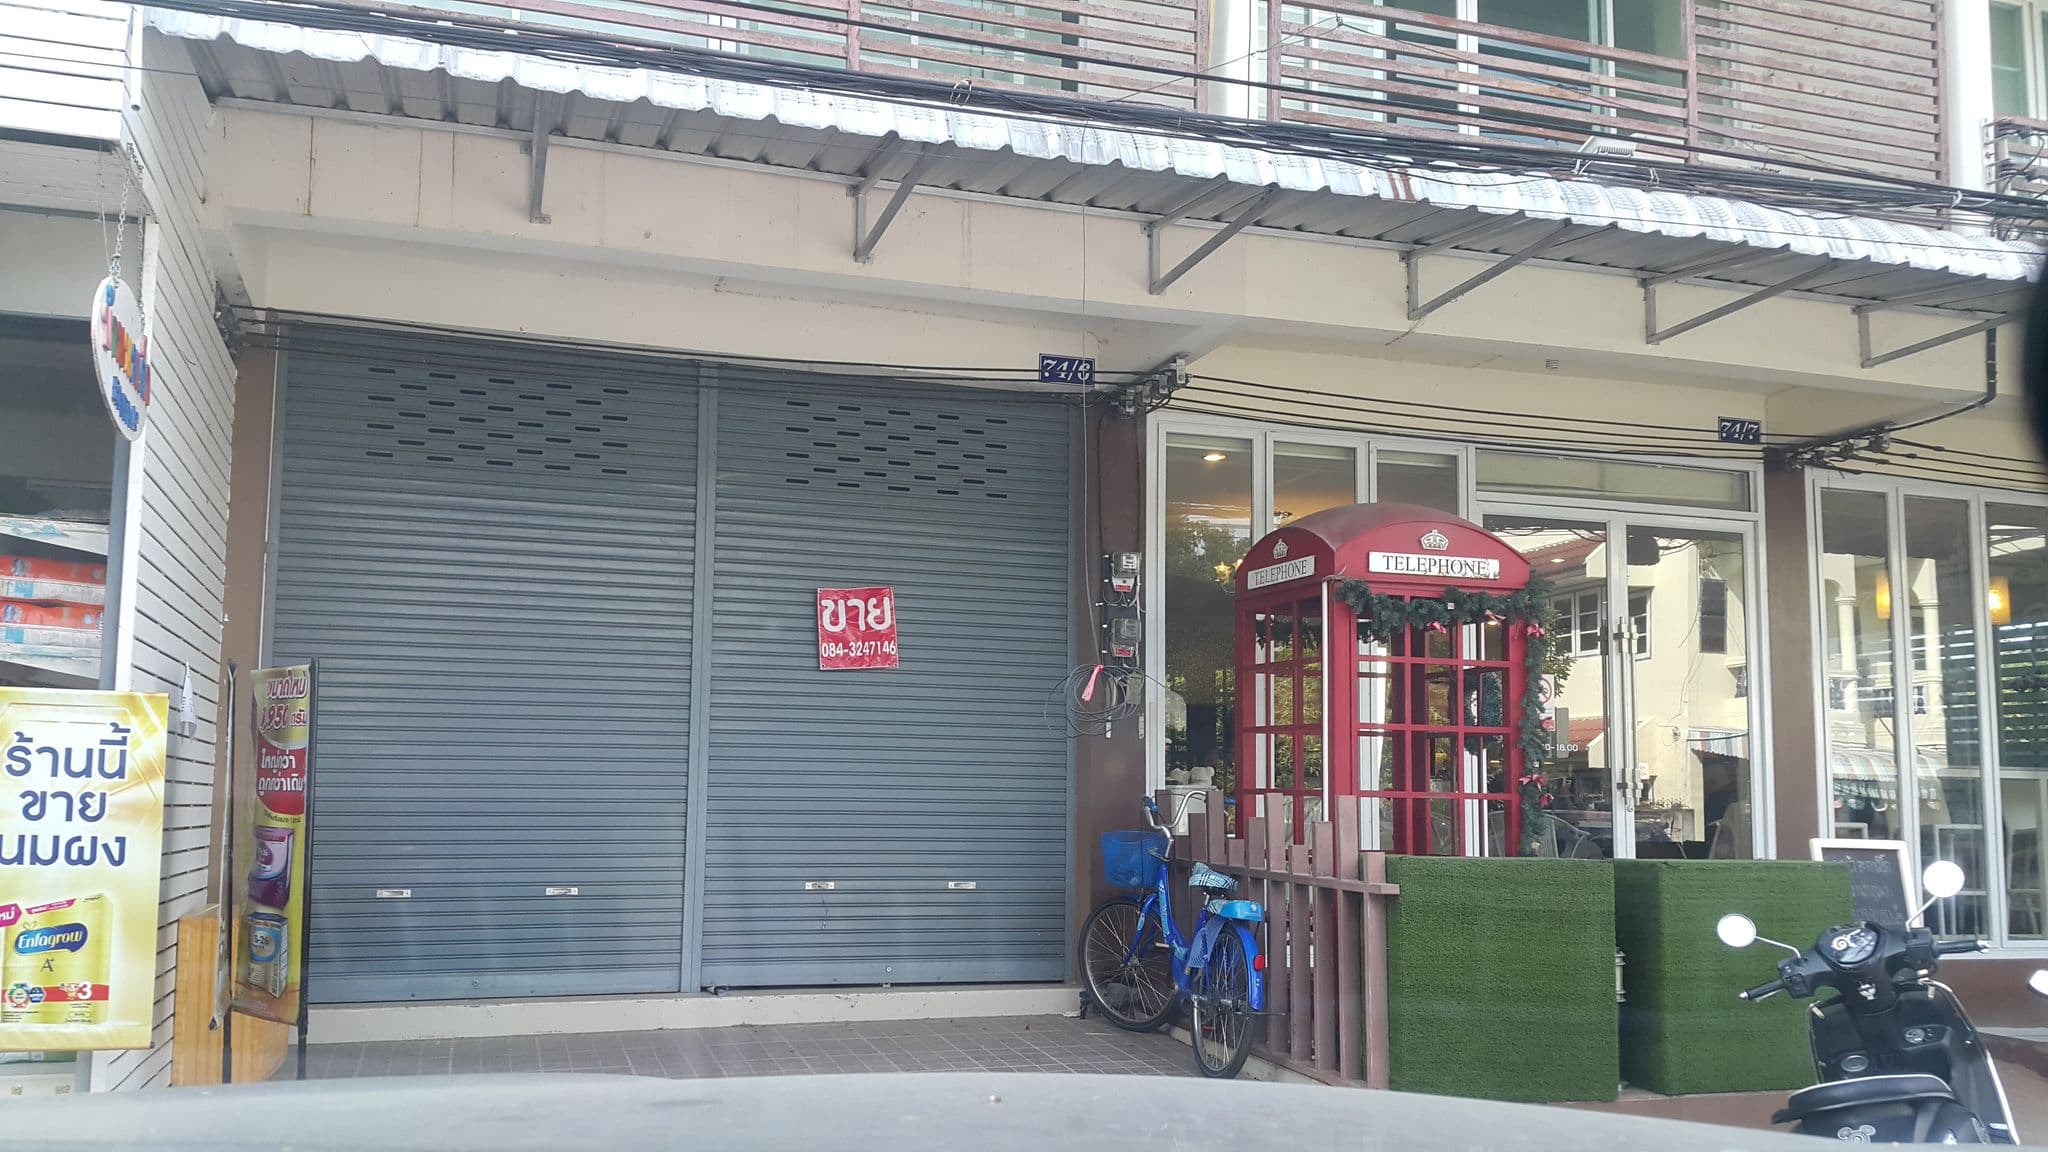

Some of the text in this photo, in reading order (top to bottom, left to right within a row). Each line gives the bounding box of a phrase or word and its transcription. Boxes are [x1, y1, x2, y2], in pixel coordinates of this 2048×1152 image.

[1043, 359, 1090, 381] 74/6
[1721, 421, 1759, 441] 74/7
[1253, 560, 1307, 586] TELEPHONE
[1383, 555, 1489, 577] TELEPHONE
[821, 596, 892, 632] ขาย
[821, 640, 896, 658] 084-3247146
[5, 722, 131, 779] ร้านนี้
[19, 790, 107, 823] ขาย
[0, 834, 127, 867] นมผง
[17, 930, 83, 950] Enfagrow
[77, 982, 93, 1000] 3
